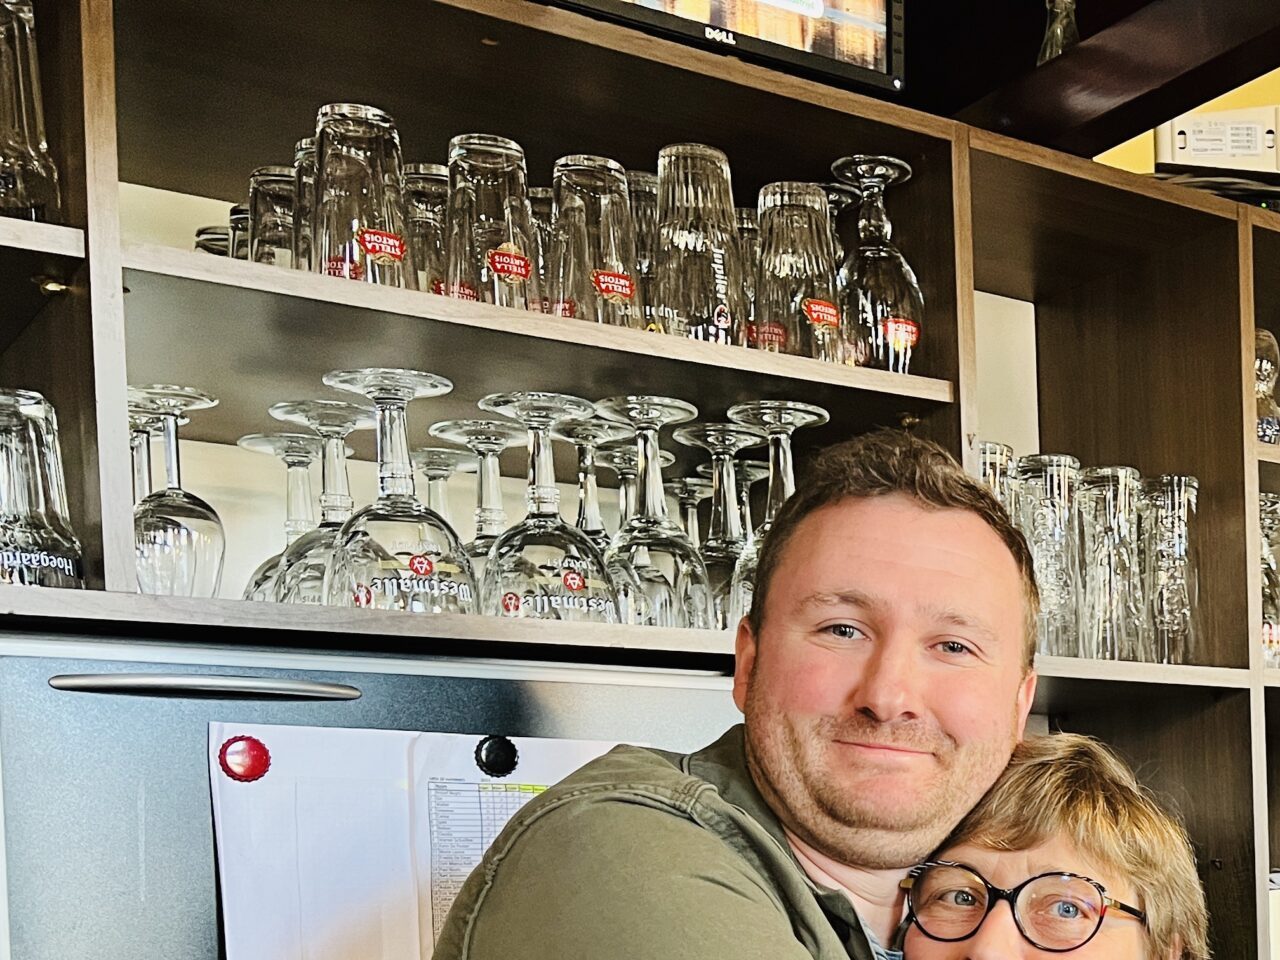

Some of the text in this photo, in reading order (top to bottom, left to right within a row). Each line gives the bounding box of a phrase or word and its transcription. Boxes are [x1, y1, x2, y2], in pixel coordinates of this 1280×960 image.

[704, 26, 736, 45] DELL
[364, 232, 401, 249] ARTOIS
[364, 241, 401, 256] STELLA
[494, 254, 526, 267] ARTOIS
[495, 263, 526, 275] STELLA
[711, 247, 730, 305] Jupiler
[598, 274, 631, 288] ARTOIS
[600, 282, 632, 295] STELLA
[370, 576, 473, 602] Westmalle
[521, 593, 616, 623] Westmalle
